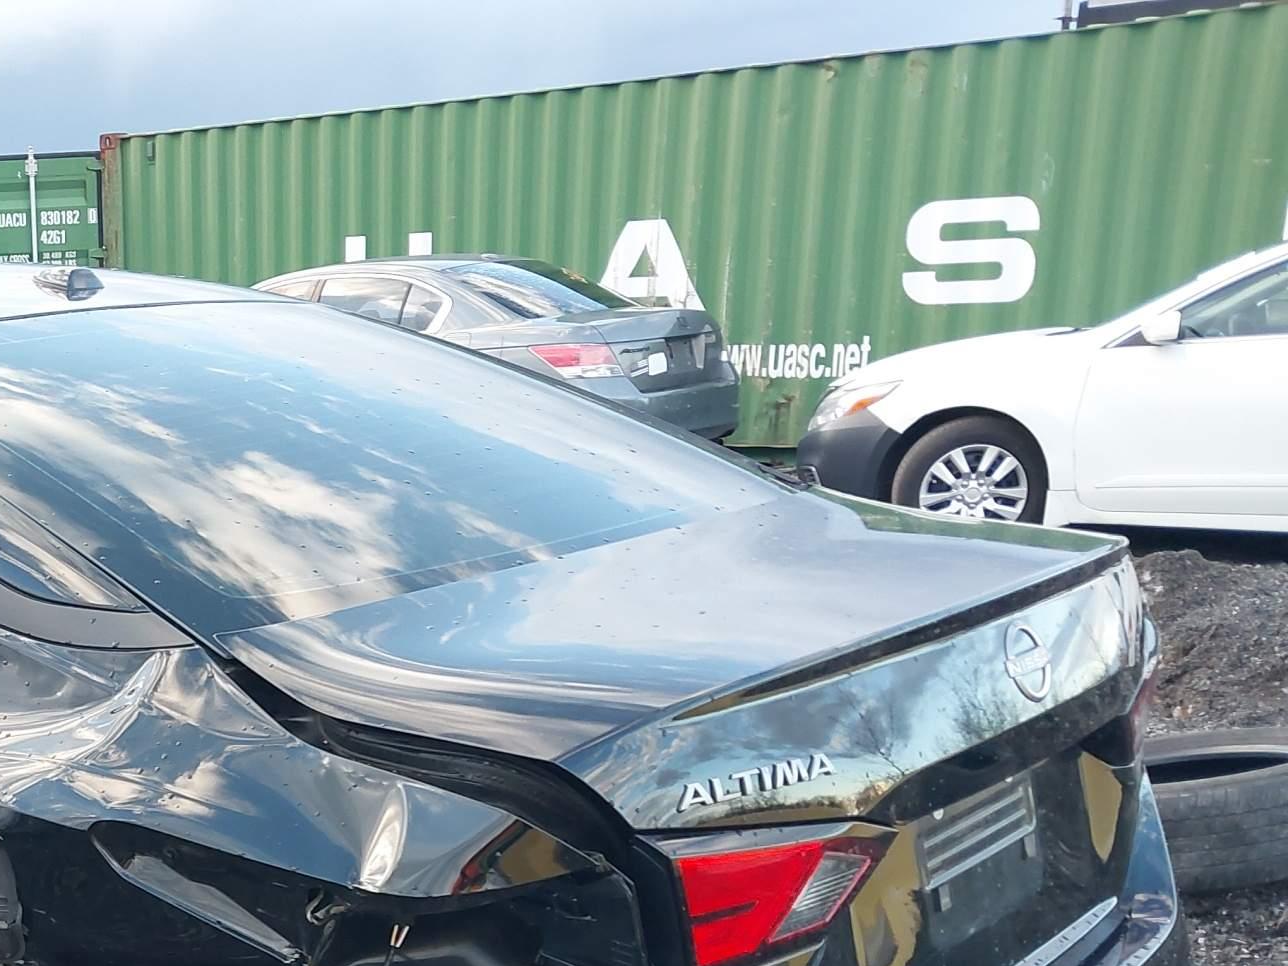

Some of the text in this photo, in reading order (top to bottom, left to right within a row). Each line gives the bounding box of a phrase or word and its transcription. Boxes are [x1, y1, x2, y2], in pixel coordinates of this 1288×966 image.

[40, 210, 80, 226] 830182
[40, 230, 66, 244] 42G1
[902, 195, 1041, 305] S
[676, 752, 837, 814] ALTIMA
